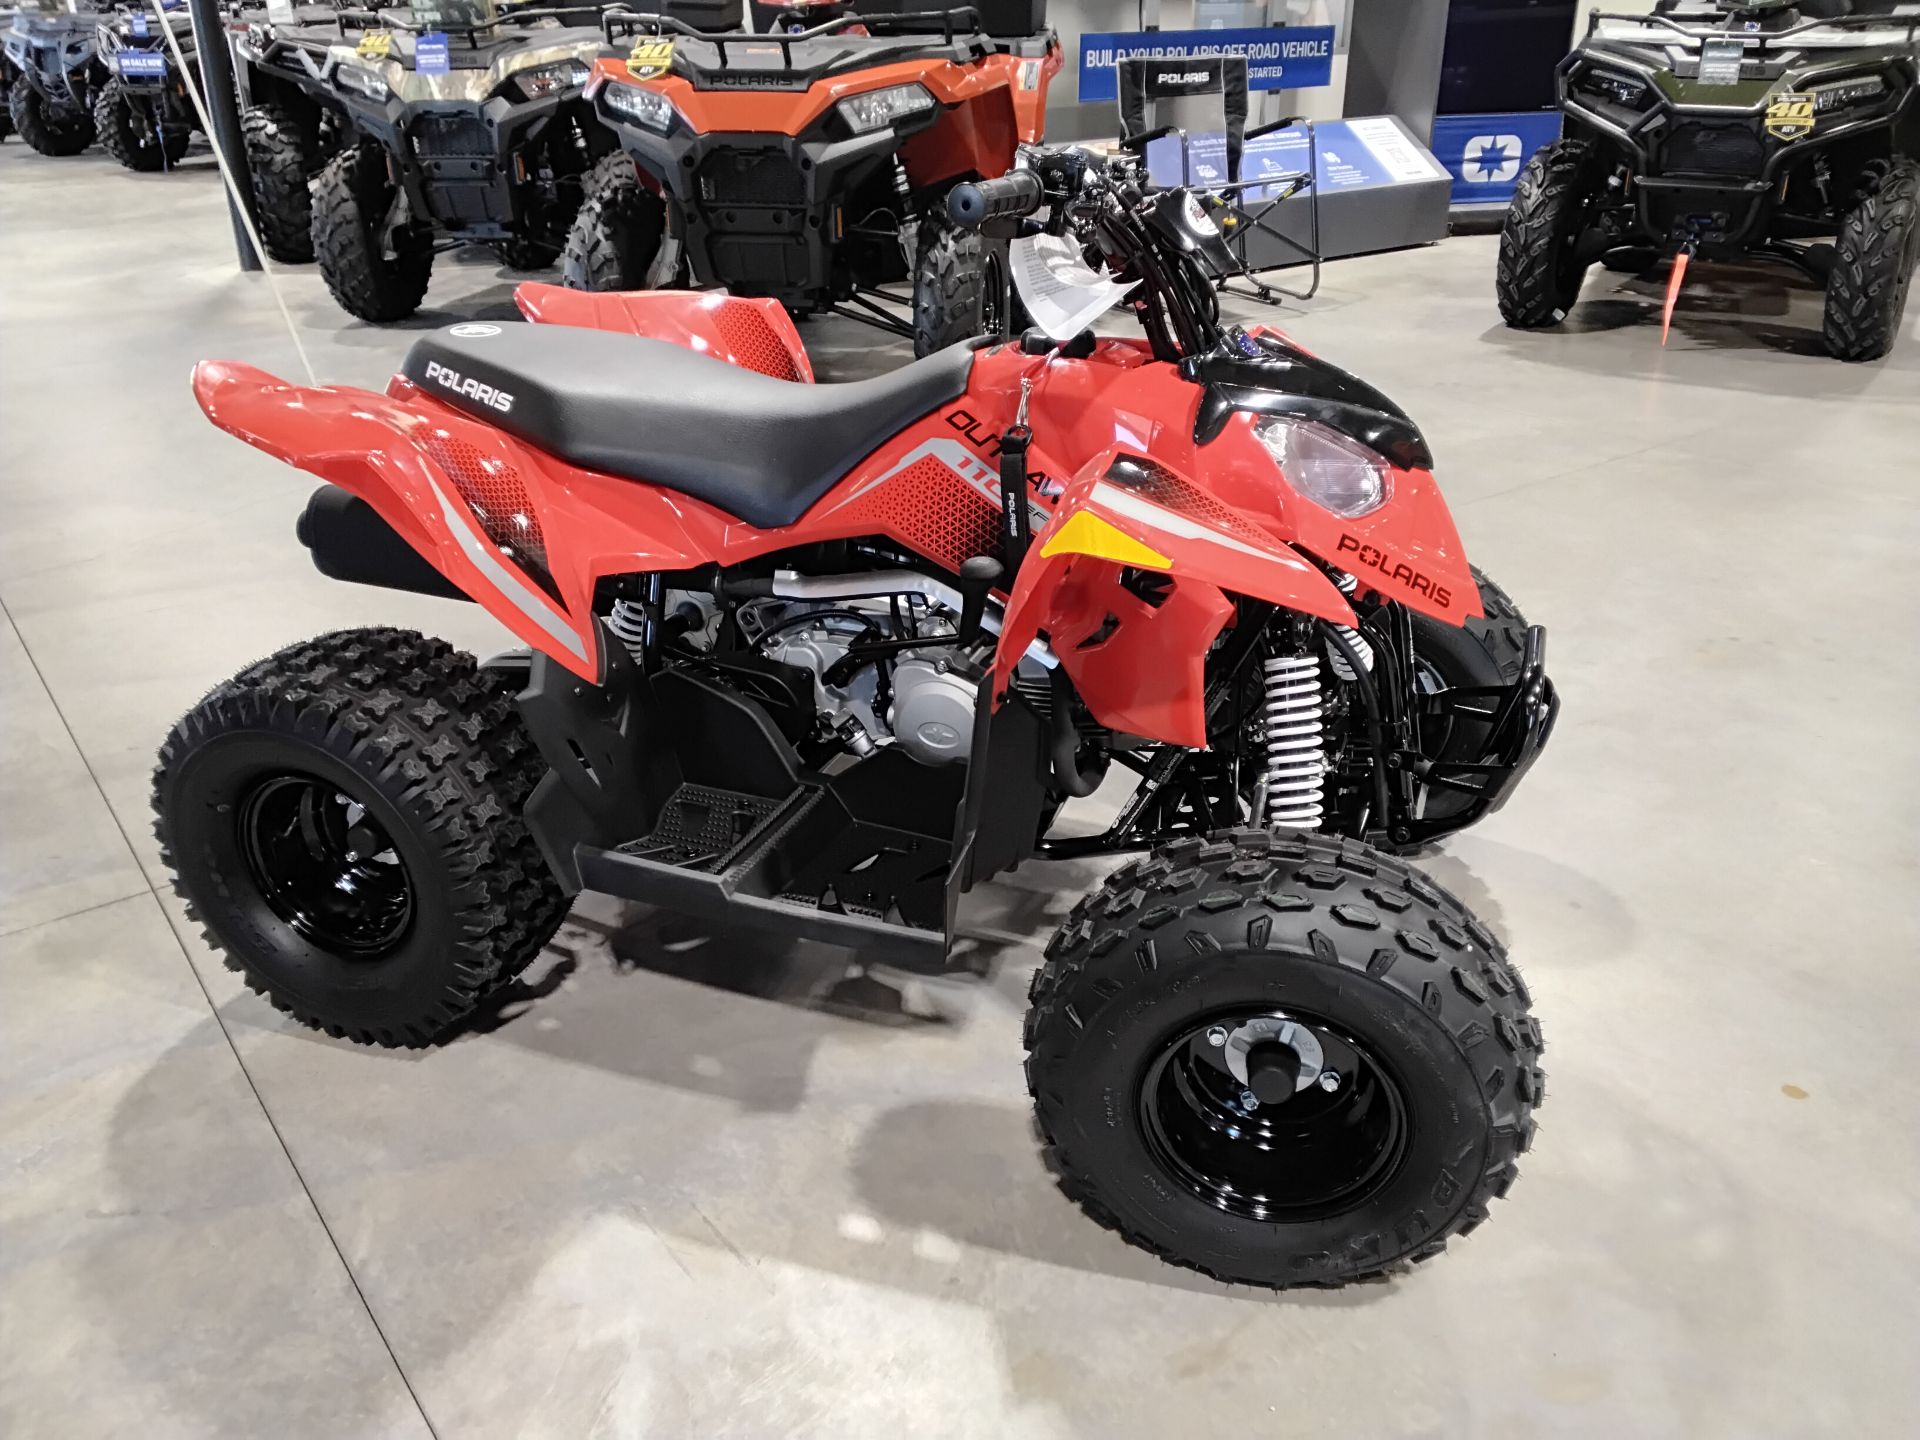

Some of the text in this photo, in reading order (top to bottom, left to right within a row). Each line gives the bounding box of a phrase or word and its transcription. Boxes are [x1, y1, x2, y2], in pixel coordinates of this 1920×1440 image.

[1086, 48, 1126, 68] BUILD
[1248, 42, 1280, 60] ROAD
[1282, 40, 1329, 58] VEHICLE
[709, 75, 793, 86] POLARIS
[1157, 71, 1210, 84] POLARIS
[1248, 65, 1283, 79] STARTED
[1765, 101, 1813, 118] 40
[425, 360, 514, 413] POLARIS
[1008, 491, 1018, 538] POLARIS
[1336, 532, 1452, 609] POLARIS
